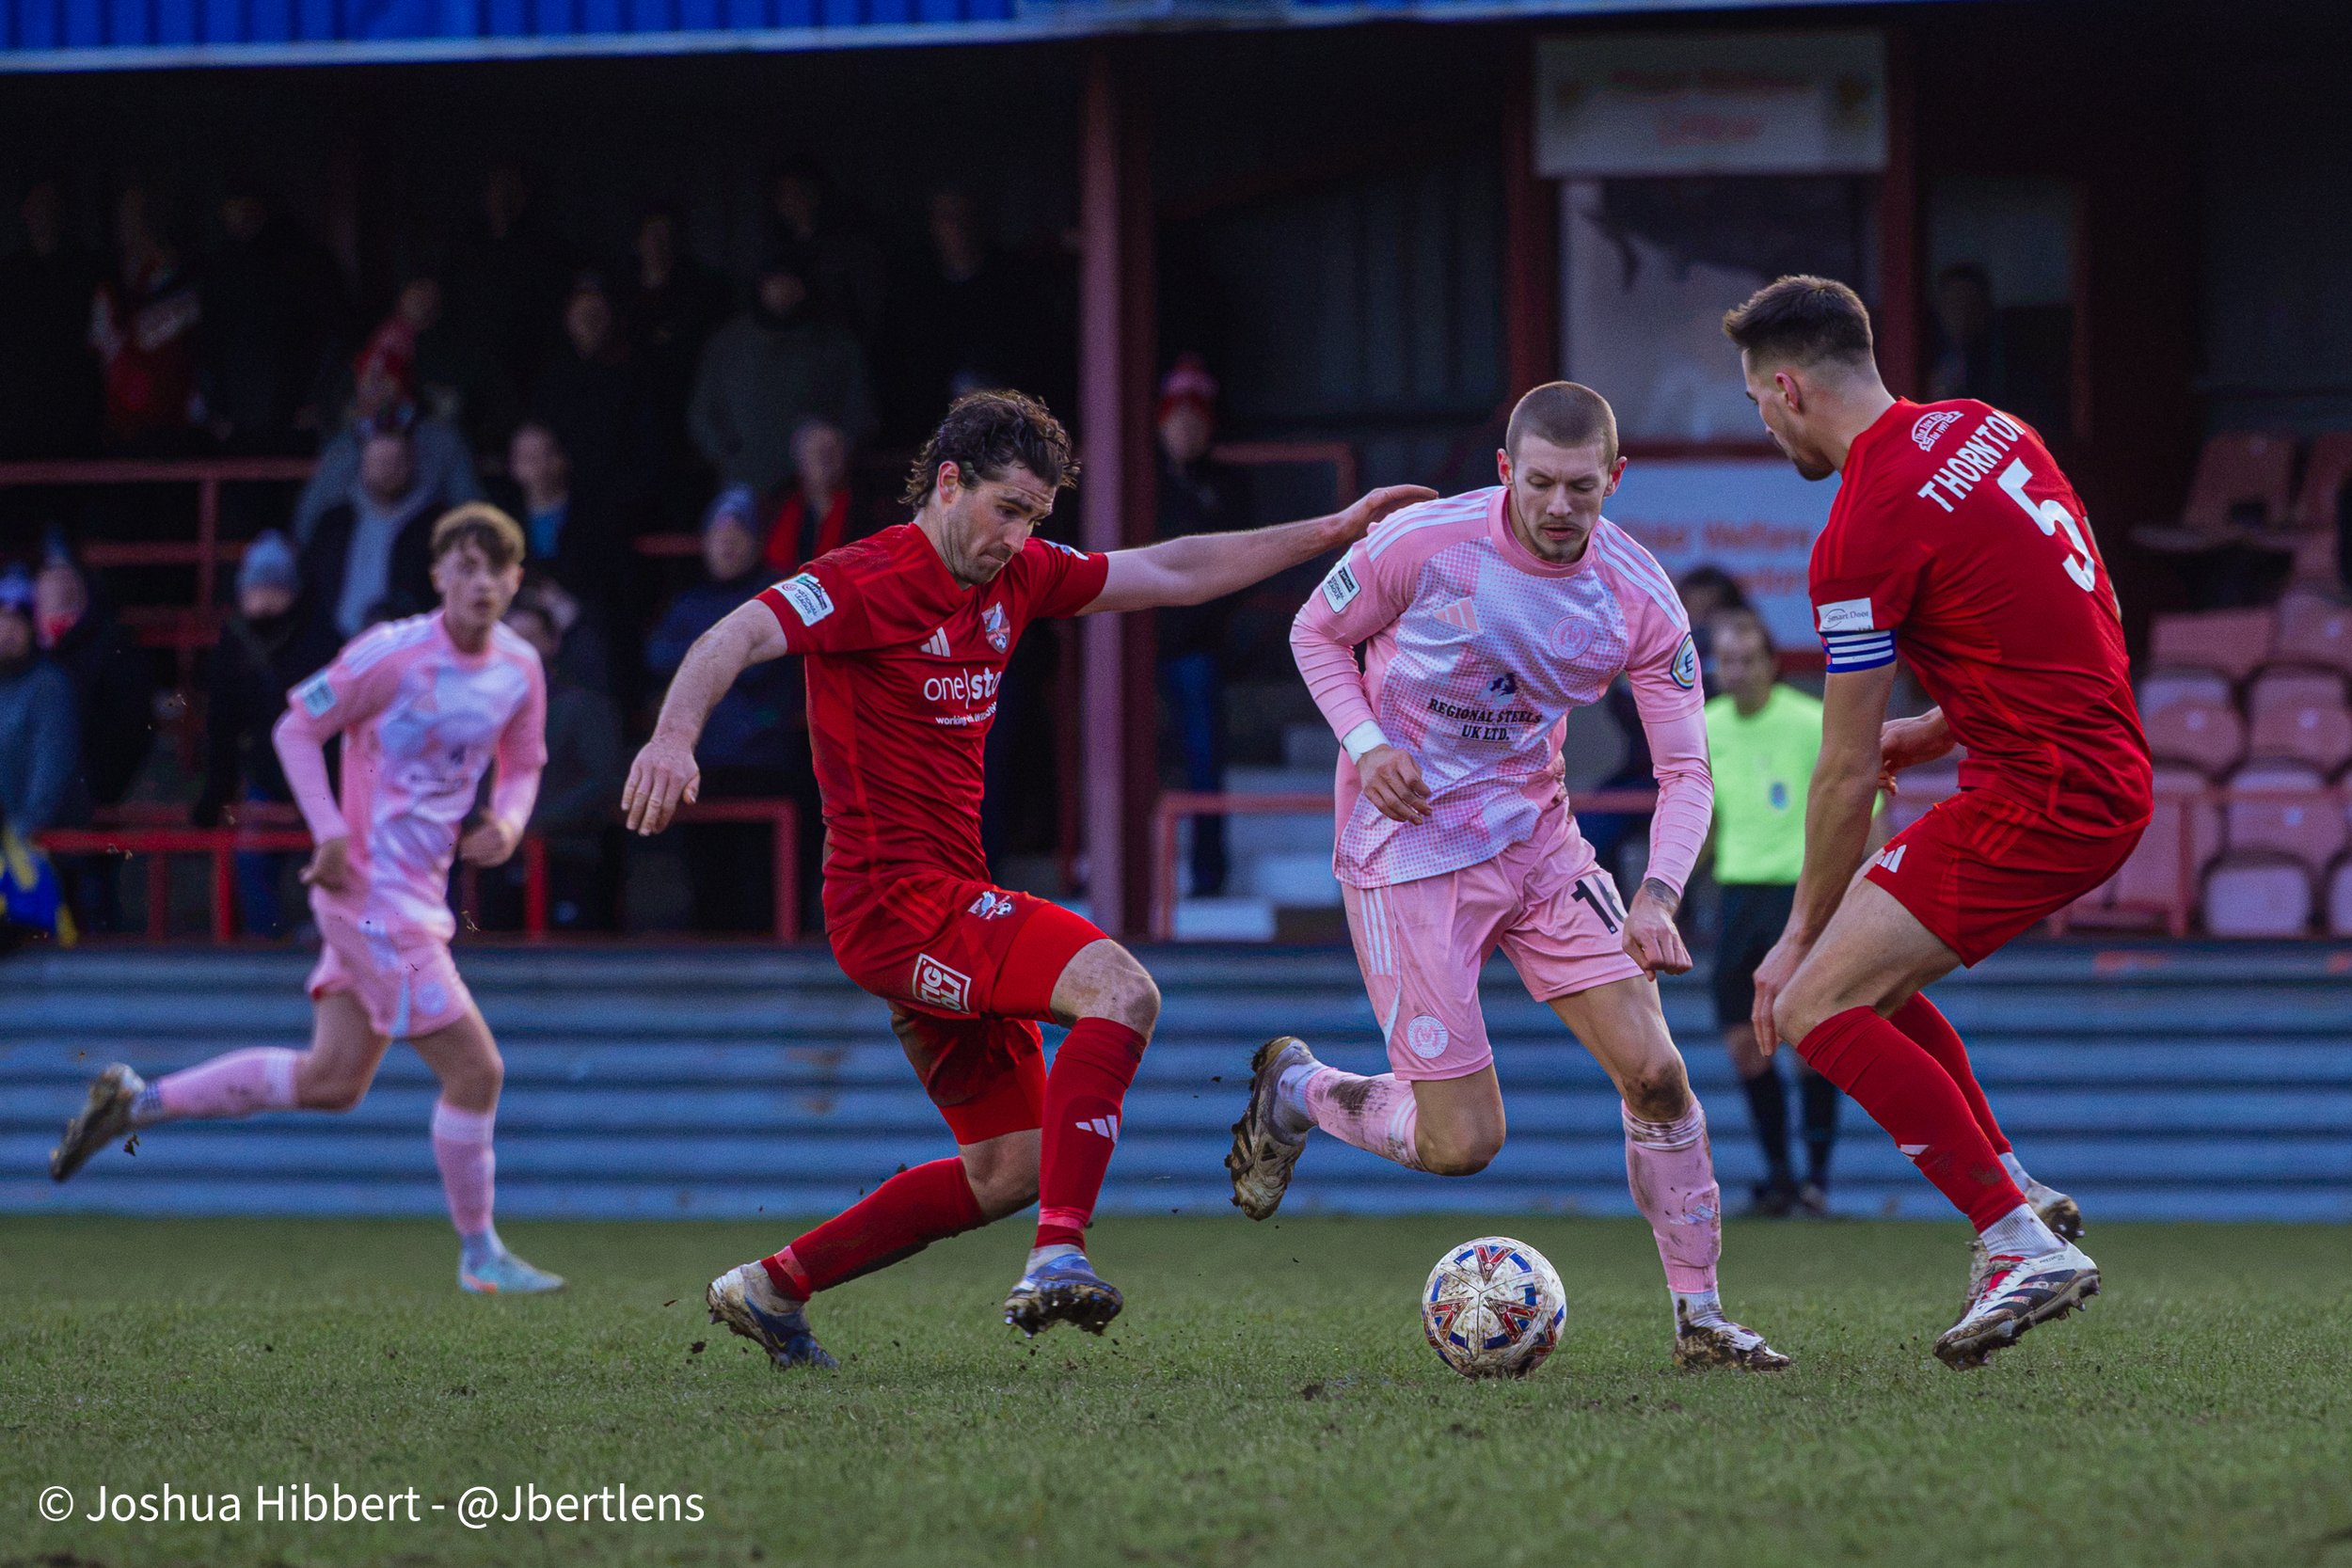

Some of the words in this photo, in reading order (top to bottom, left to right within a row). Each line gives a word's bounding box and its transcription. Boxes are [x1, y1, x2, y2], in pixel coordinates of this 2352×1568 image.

[1997, 457, 2095, 592] 5
[1827, 612, 1848, 622] Smart
[1429, 698, 1492, 723] REGIONAL
[1496, 709, 1543, 723] STEELS
[1461, 724, 1480, 739] UK
[1484, 726, 1510, 740] LTD.
